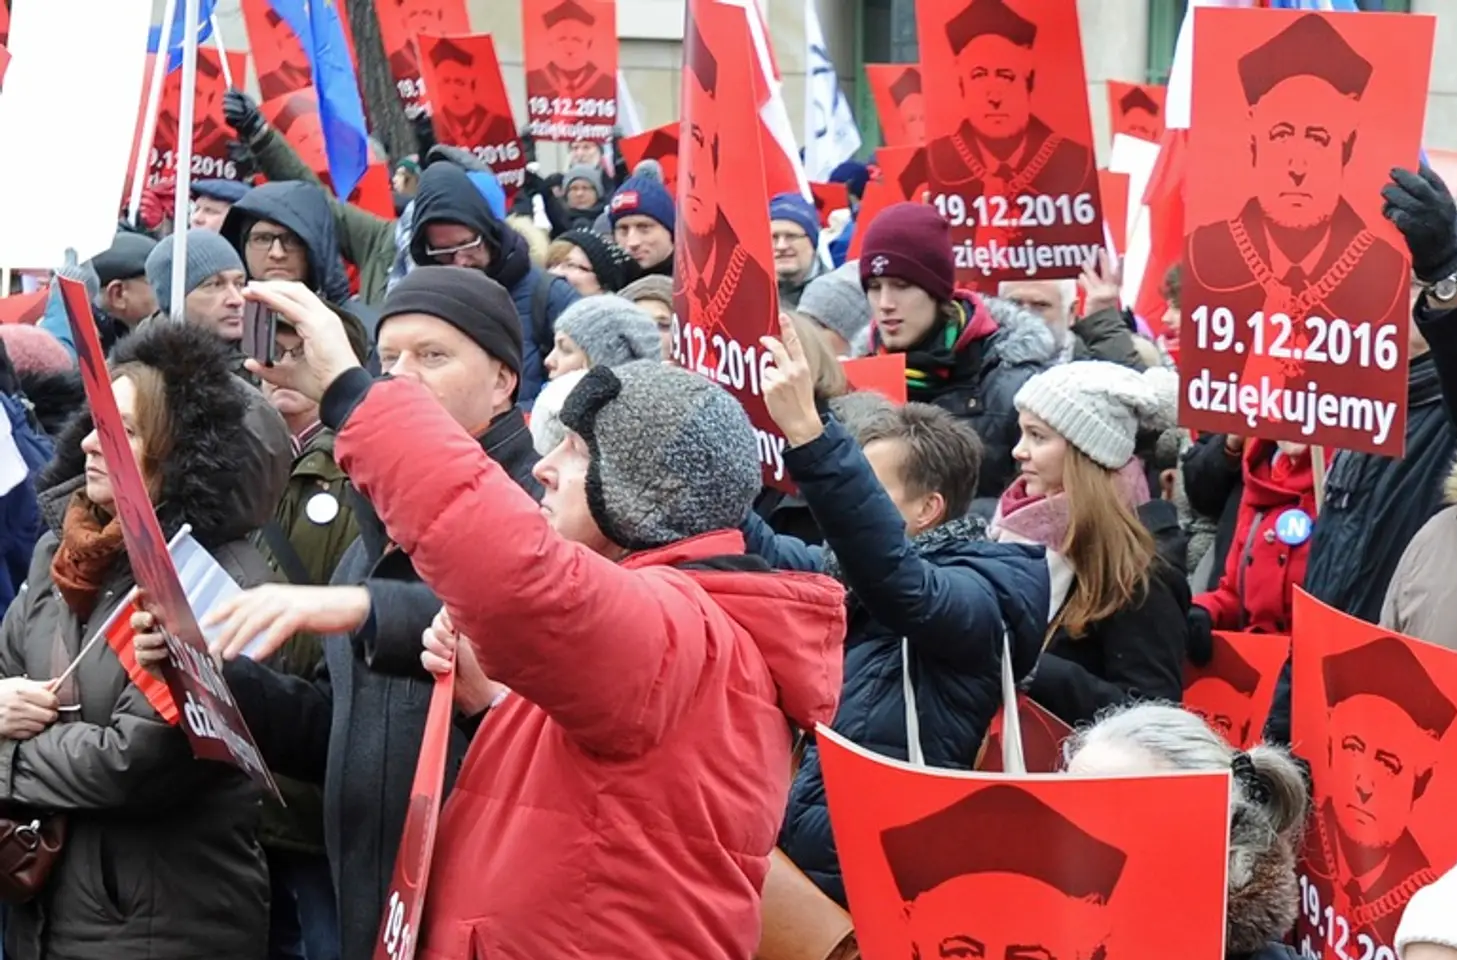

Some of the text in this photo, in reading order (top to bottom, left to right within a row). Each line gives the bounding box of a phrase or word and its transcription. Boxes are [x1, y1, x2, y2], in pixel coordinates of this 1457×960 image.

[529, 96, 616, 117] 19.12.2016
[934, 193, 1096, 227] 19.12.2016
[953, 238, 1099, 276] ziękujemy
[671, 313, 774, 396] 9.12.201
[1191, 305, 1399, 371] 19.12.2016
[1188, 369, 1397, 445] dziękujemy
